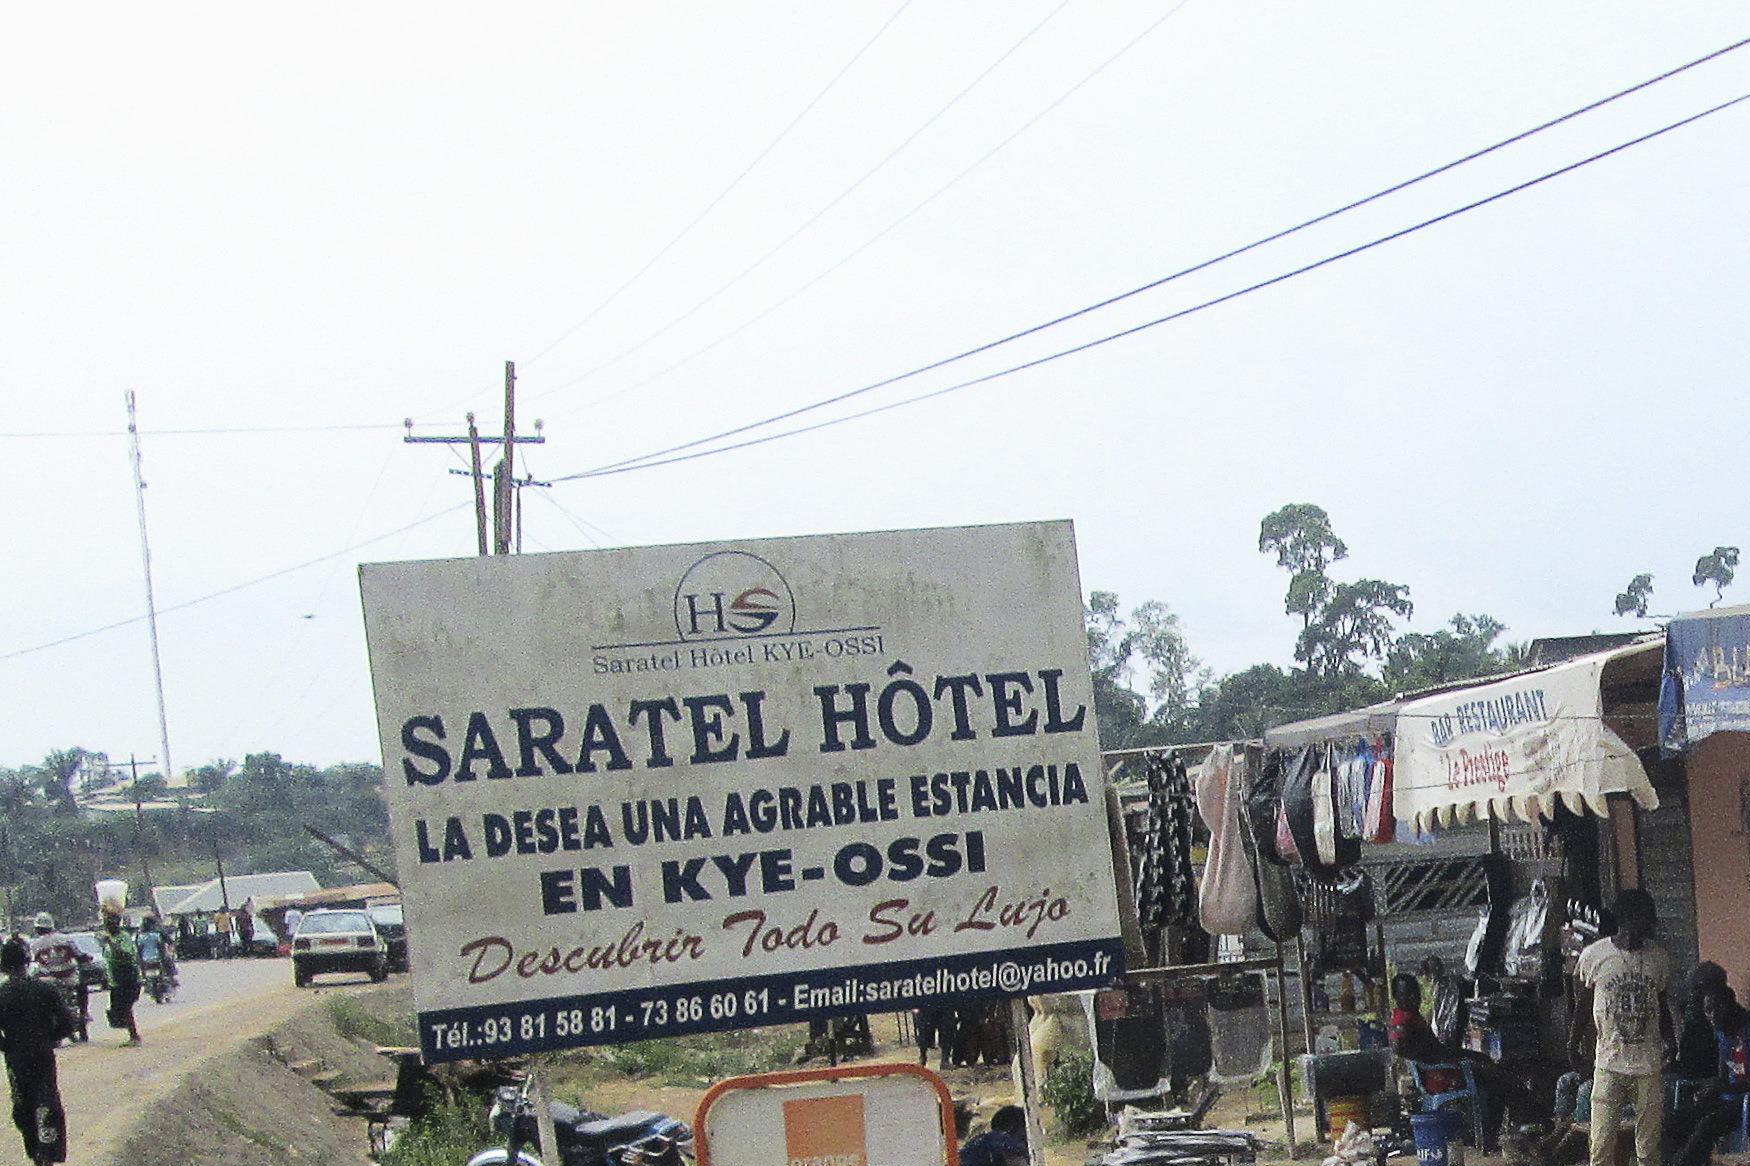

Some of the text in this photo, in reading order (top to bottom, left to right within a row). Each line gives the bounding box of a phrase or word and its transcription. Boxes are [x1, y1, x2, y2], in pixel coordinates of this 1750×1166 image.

[592, 650, 680, 675] Saratel
[764, 635, 886, 663] KYE-OSSI
[400, 659, 1087, 786] SARATEL HÔTEL
[1431, 689, 1547, 747] BAR RESTAURANT
[415, 762, 1089, 864] LA DESEA UNA AGRABLE ESTANCIA
[540, 830, 987, 916] EN KYE-OSSI
[460, 886, 1071, 984] Descubrir Todo Su Lujo
[520, 1014, 546, 1040] 81
[556, 1010, 583, 1036] 58
[591, 1006, 616, 1032] 81
[640, 1002, 668, 1027] 73
[676, 997, 703, 1022] 86
[710, 993, 737, 1018] 60
[745, 988, 770, 1015] 61
